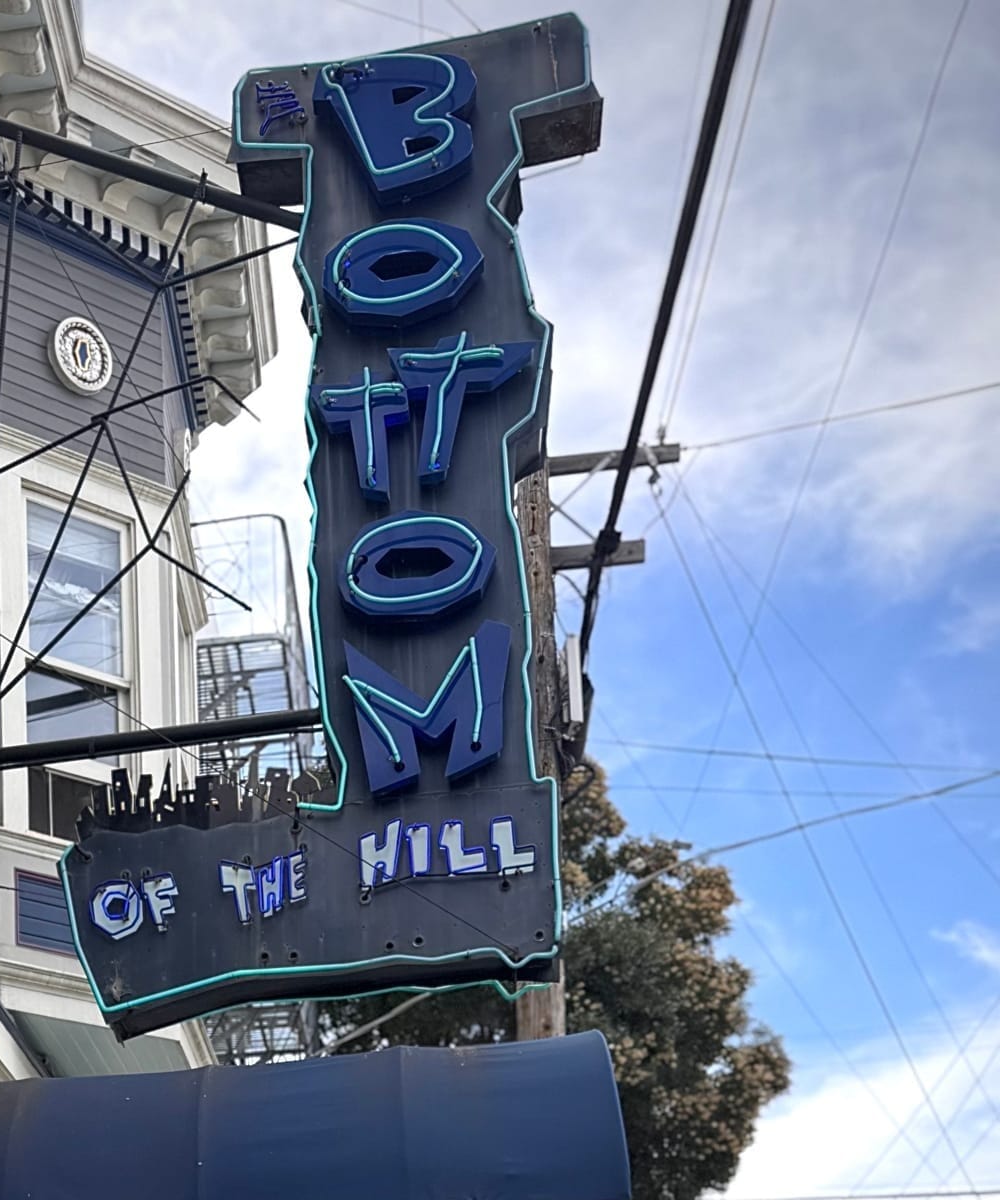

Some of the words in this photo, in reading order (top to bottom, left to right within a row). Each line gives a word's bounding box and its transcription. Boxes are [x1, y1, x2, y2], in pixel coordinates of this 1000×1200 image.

[310, 53, 538, 793] BOTTOM
[89, 873, 178, 940] OF
[218, 851, 307, 925] THE
[359, 816, 535, 889] HILL
